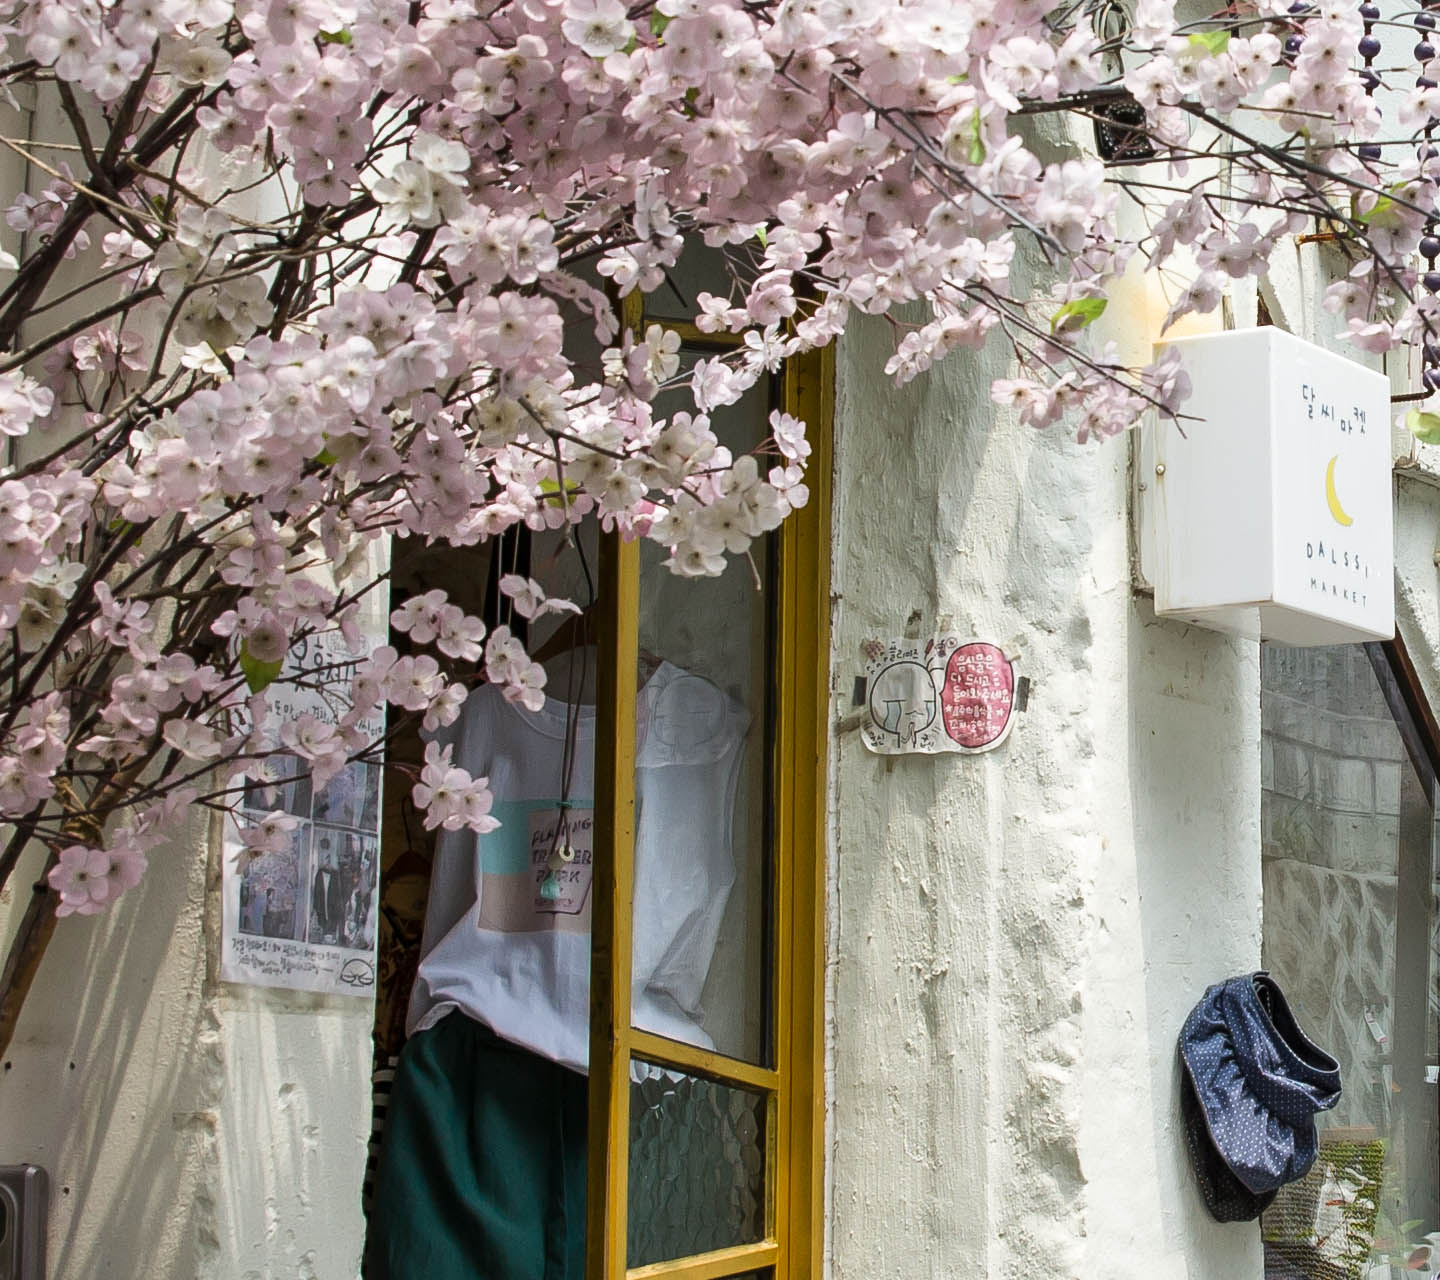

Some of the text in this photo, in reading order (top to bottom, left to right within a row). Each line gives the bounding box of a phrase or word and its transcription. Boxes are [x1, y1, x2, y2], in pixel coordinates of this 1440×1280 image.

[1306, 540, 1369, 578] DALSSI
[1310, 577, 1367, 608] MARKET
[956, 653, 994, 674] 음식물은
